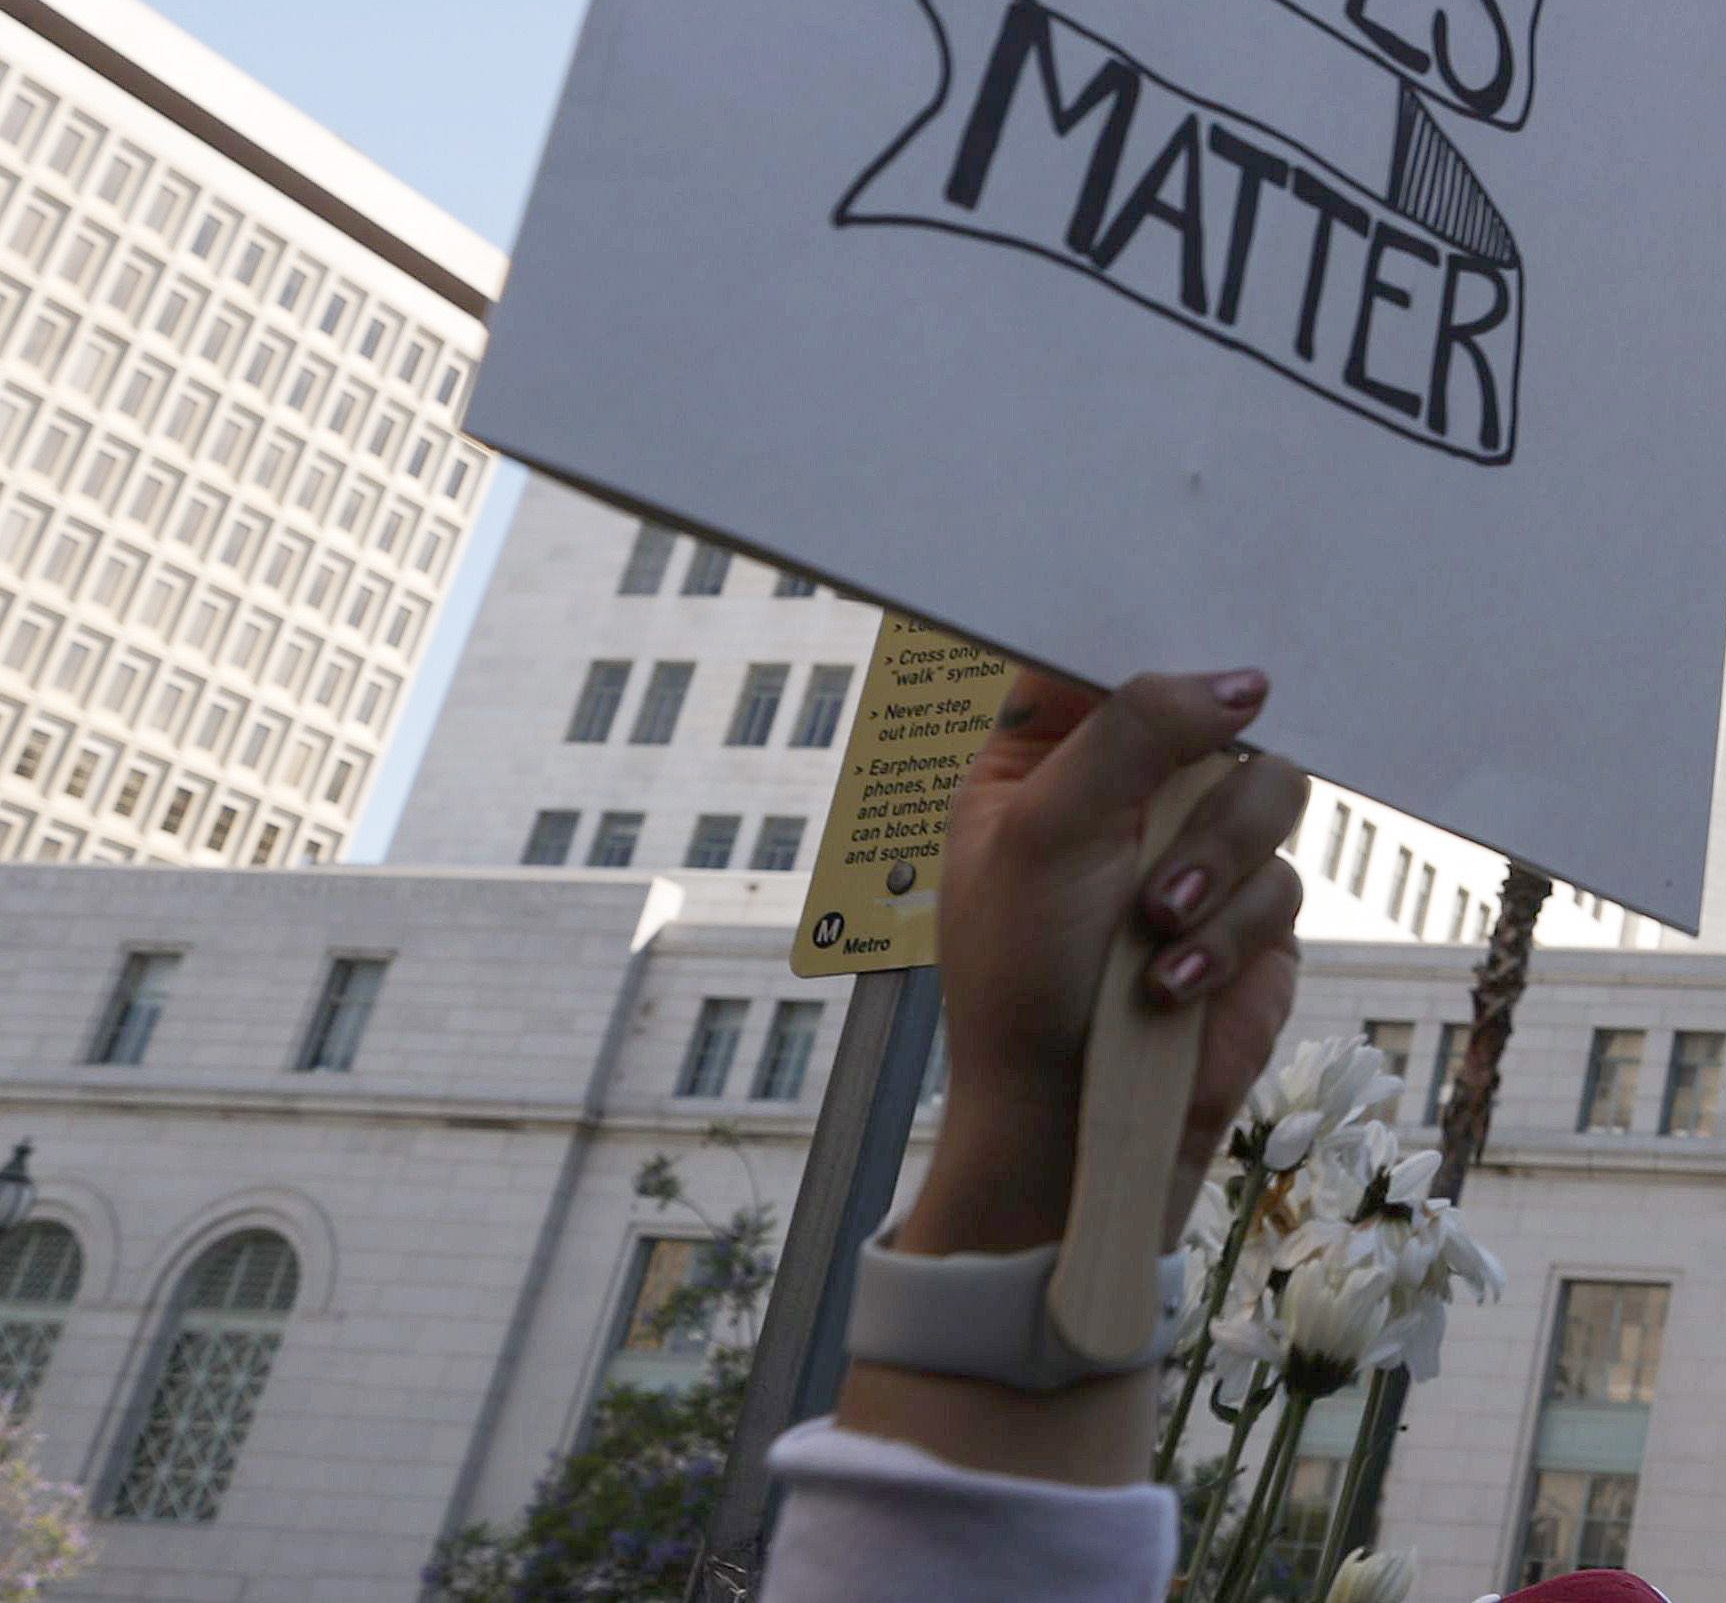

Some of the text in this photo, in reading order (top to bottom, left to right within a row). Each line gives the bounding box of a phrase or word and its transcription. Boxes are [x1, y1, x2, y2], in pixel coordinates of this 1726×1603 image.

[944, 0, 1510, 450] MATTER
[899, 648, 945, 665] Cross
[891, 660, 1005, 686] "walk" symbol
[884, 698, 971, 720] Never step
[878, 715, 993, 742] out into traffic
[869, 755, 960, 776] Earphones,
[863, 779, 926, 801] phones,
[857, 795, 953, 820] and umbrel
[851, 828, 880, 842] can
[884, 819, 928, 838] block
[845, 841, 939, 865] and sounds
[815, 916, 842, 945] M
[842, 937, 891, 954] Metro
